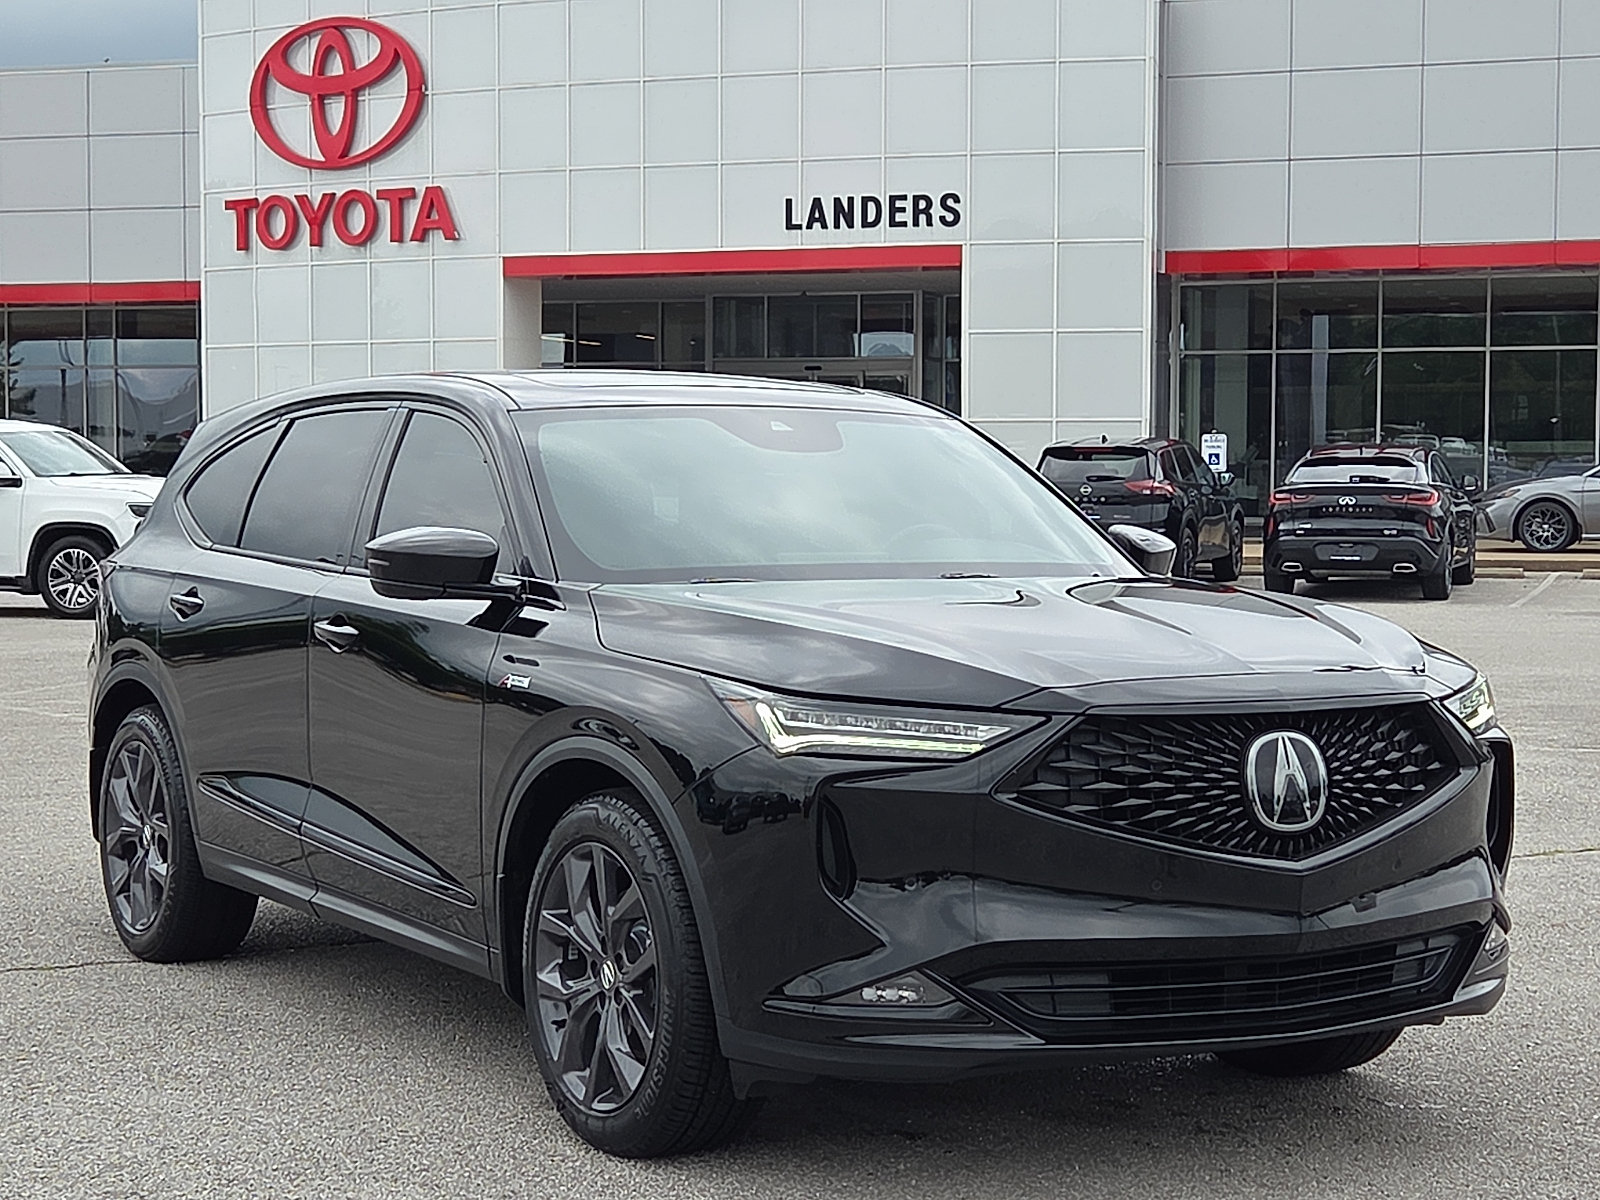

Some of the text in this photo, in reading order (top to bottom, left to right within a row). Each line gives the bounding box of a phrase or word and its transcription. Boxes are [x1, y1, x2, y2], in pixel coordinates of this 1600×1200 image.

[225, 186, 459, 251] TOYOTA
[785, 193, 961, 230] LANDERS
[602, 812, 647, 867] ALENZA
